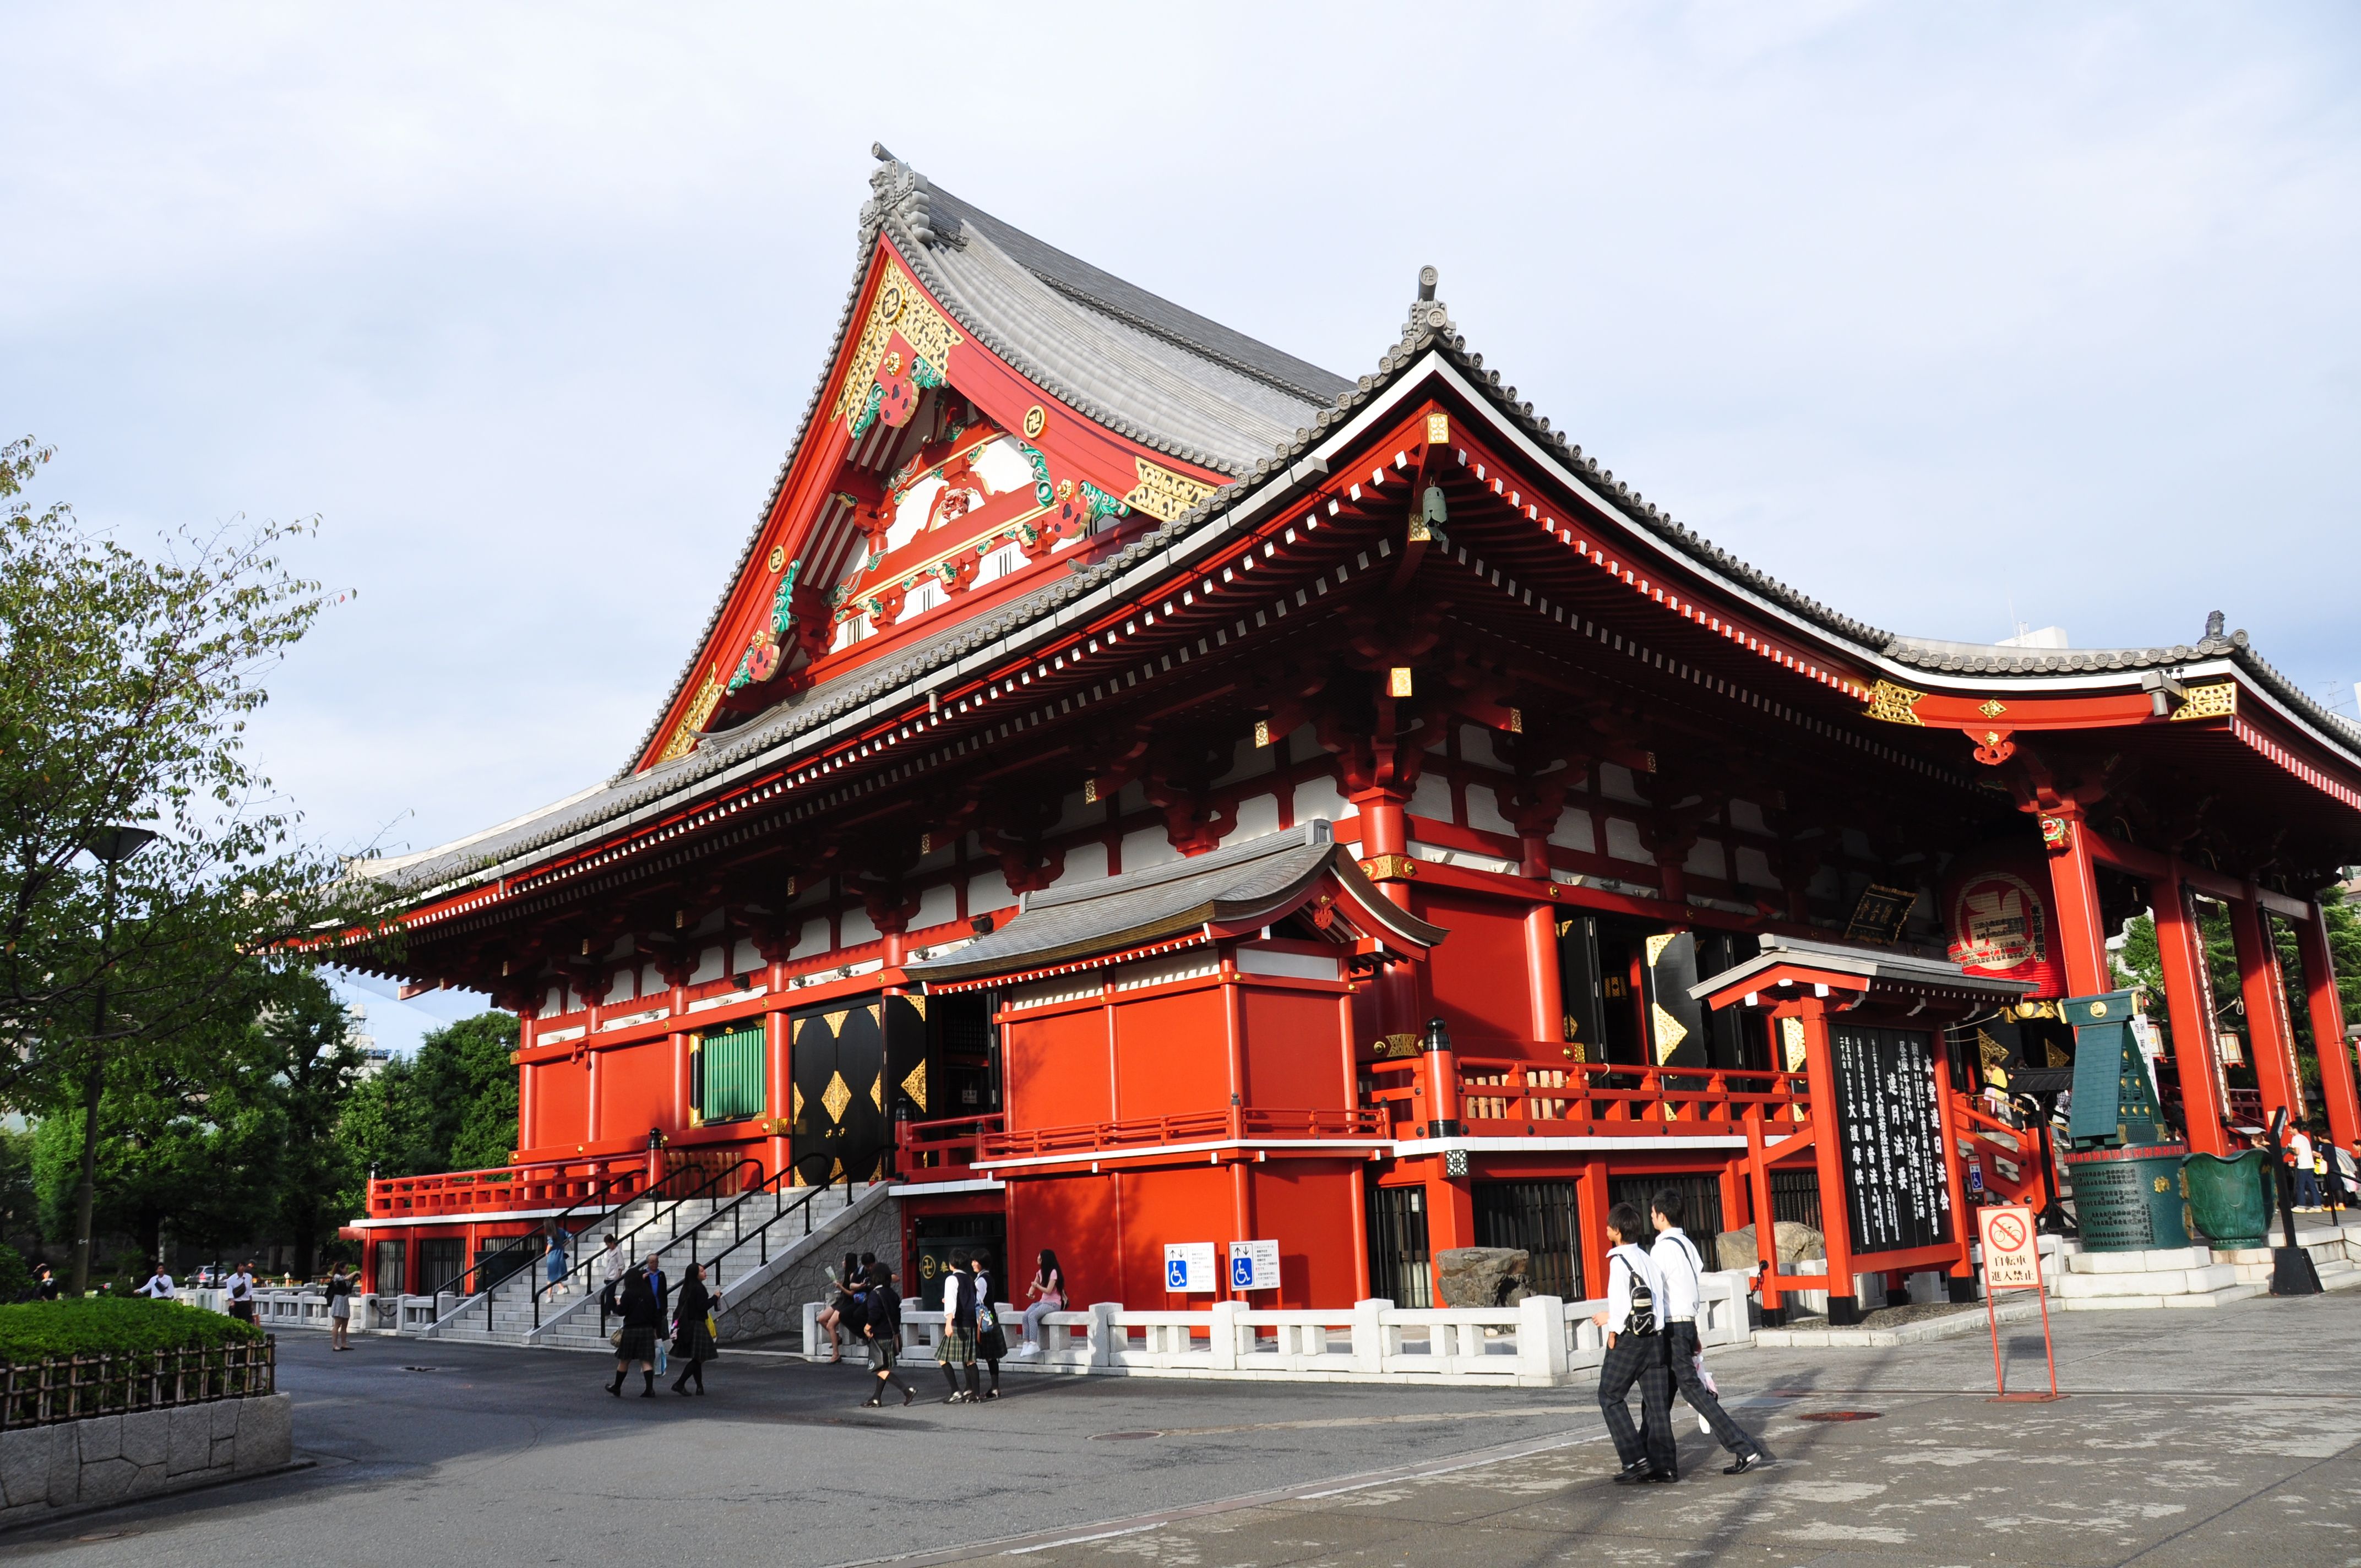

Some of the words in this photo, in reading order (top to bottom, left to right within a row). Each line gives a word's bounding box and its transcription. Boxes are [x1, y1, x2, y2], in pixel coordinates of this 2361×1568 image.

[2030, 905, 2046, 962] 東京新橋組合
[1847, 1101, 1864, 1185] 大護摩供
[1886, 1072, 1908, 1190] 連月法要
[1924, 1054, 1950, 1211] 本堂連日法会
[1991, 1270, 2035, 1282] 進入禁止
[1994, 1255, 2027, 1267] 自転車
